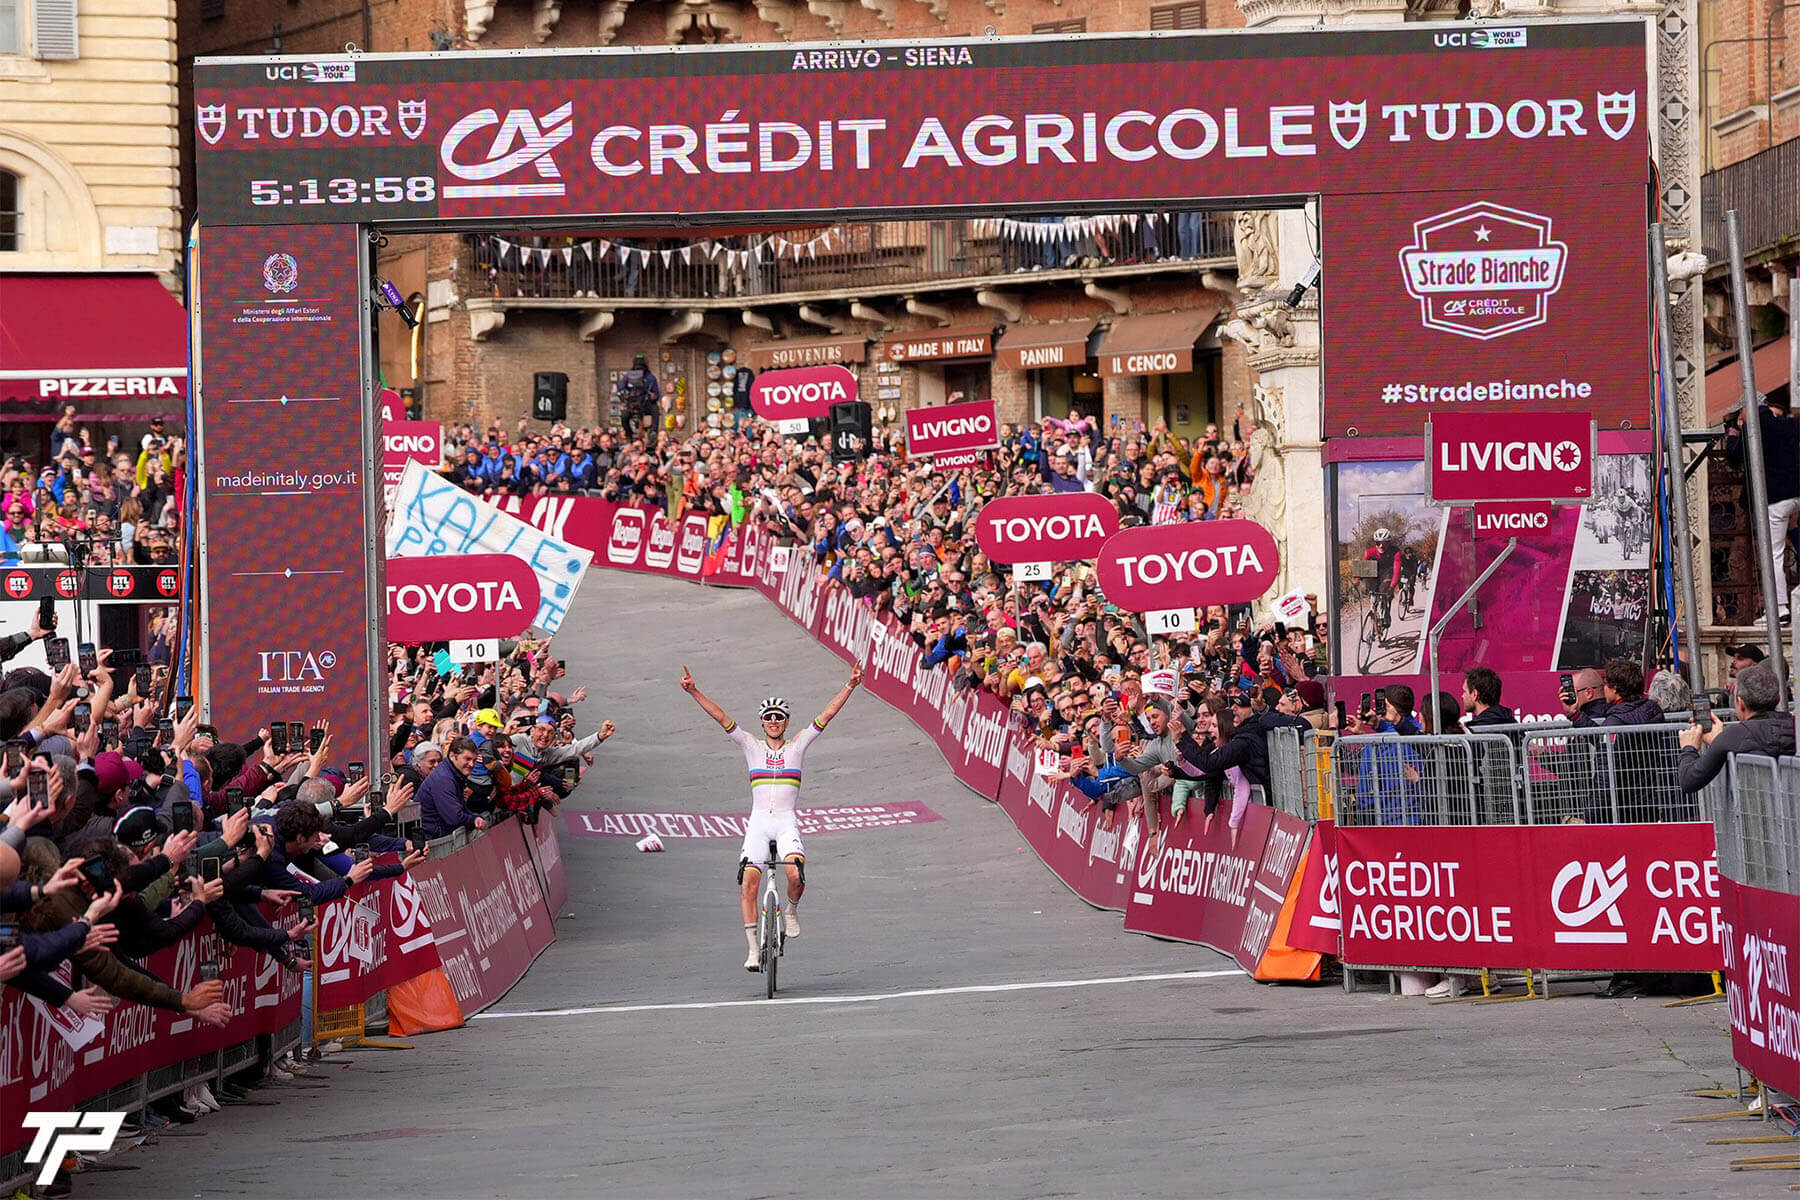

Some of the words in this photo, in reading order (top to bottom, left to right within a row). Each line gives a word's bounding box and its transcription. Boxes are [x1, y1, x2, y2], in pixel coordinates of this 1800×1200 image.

[1434, 33, 1467, 48] UCI
[1492, 31, 1521, 40] WORLD
[1494, 38, 1515, 46] TOUR
[322, 64, 350, 73] WORLD
[791, 48, 881, 71] ARRIVO
[905, 46, 974, 67] SIENA
[266, 66, 298, 81] UCI
[324, 72, 344, 80] TOUR
[237, 105, 391, 140] TUDOR
[1382, 99, 1588, 142] TUDOR
[590, 109, 886, 176] CRÉDIT
[902, 105, 1316, 169] AGRICOLE
[251, 176, 436, 207] 5:13:58
[1418, 258, 1476, 286] Strade
[1482, 255, 1549, 284] Bianche
[1468, 307, 1525, 316] AGRICOLE
[772, 346, 842, 365] SOUVENIRS
[908, 342, 938, 358] MADE
[942, 341, 954, 355] IN
[956, 338, 985, 354] ITALY
[1020, 346, 1064, 367] PANINI
[1112, 357, 1122, 373] IL
[1127, 353, 1177, 372] CENCIO
[39, 377, 178, 397] PIZZERIA
[760, 381, 848, 408] TOYOTA
[1382, 379, 1592, 403] #StradeBianche
[790, 421, 802, 433] 50
[912, 415, 991, 441] LIVIGNO
[383, 435, 435, 452] IGNO
[935, 454, 976, 468] LIVIGNO
[1441, 440, 1582, 472] LIVIGNO
[216, 470, 357, 489] madeinitaly.gov.it
[990, 514, 1105, 543] TOYOTA
[1477, 511, 1548, 530] LIVIGNO
[1025, 565, 1041, 576] 25
[1116, 544, 1263, 587] TOYOTA
[10, 577, 27, 586] RTL
[113, 576, 129, 584] RTL
[386, 581, 522, 614] TOYOTA
[1161, 613, 1180, 628] 10
[466, 643, 486, 658] 10
[258, 652, 324, 682] ITA
[301, 685, 324, 693] AGENCY
[801, 818, 912, 834] d'Europa
[823, 811, 917, 823] leggera
[1159, 838, 1214, 898] CRÉDIT
[1345, 851, 1459, 898] CRÉDIT
[1350, 905, 1513, 943] AGRICOLE
[109, 1003, 157, 1056] AGRICOLE
